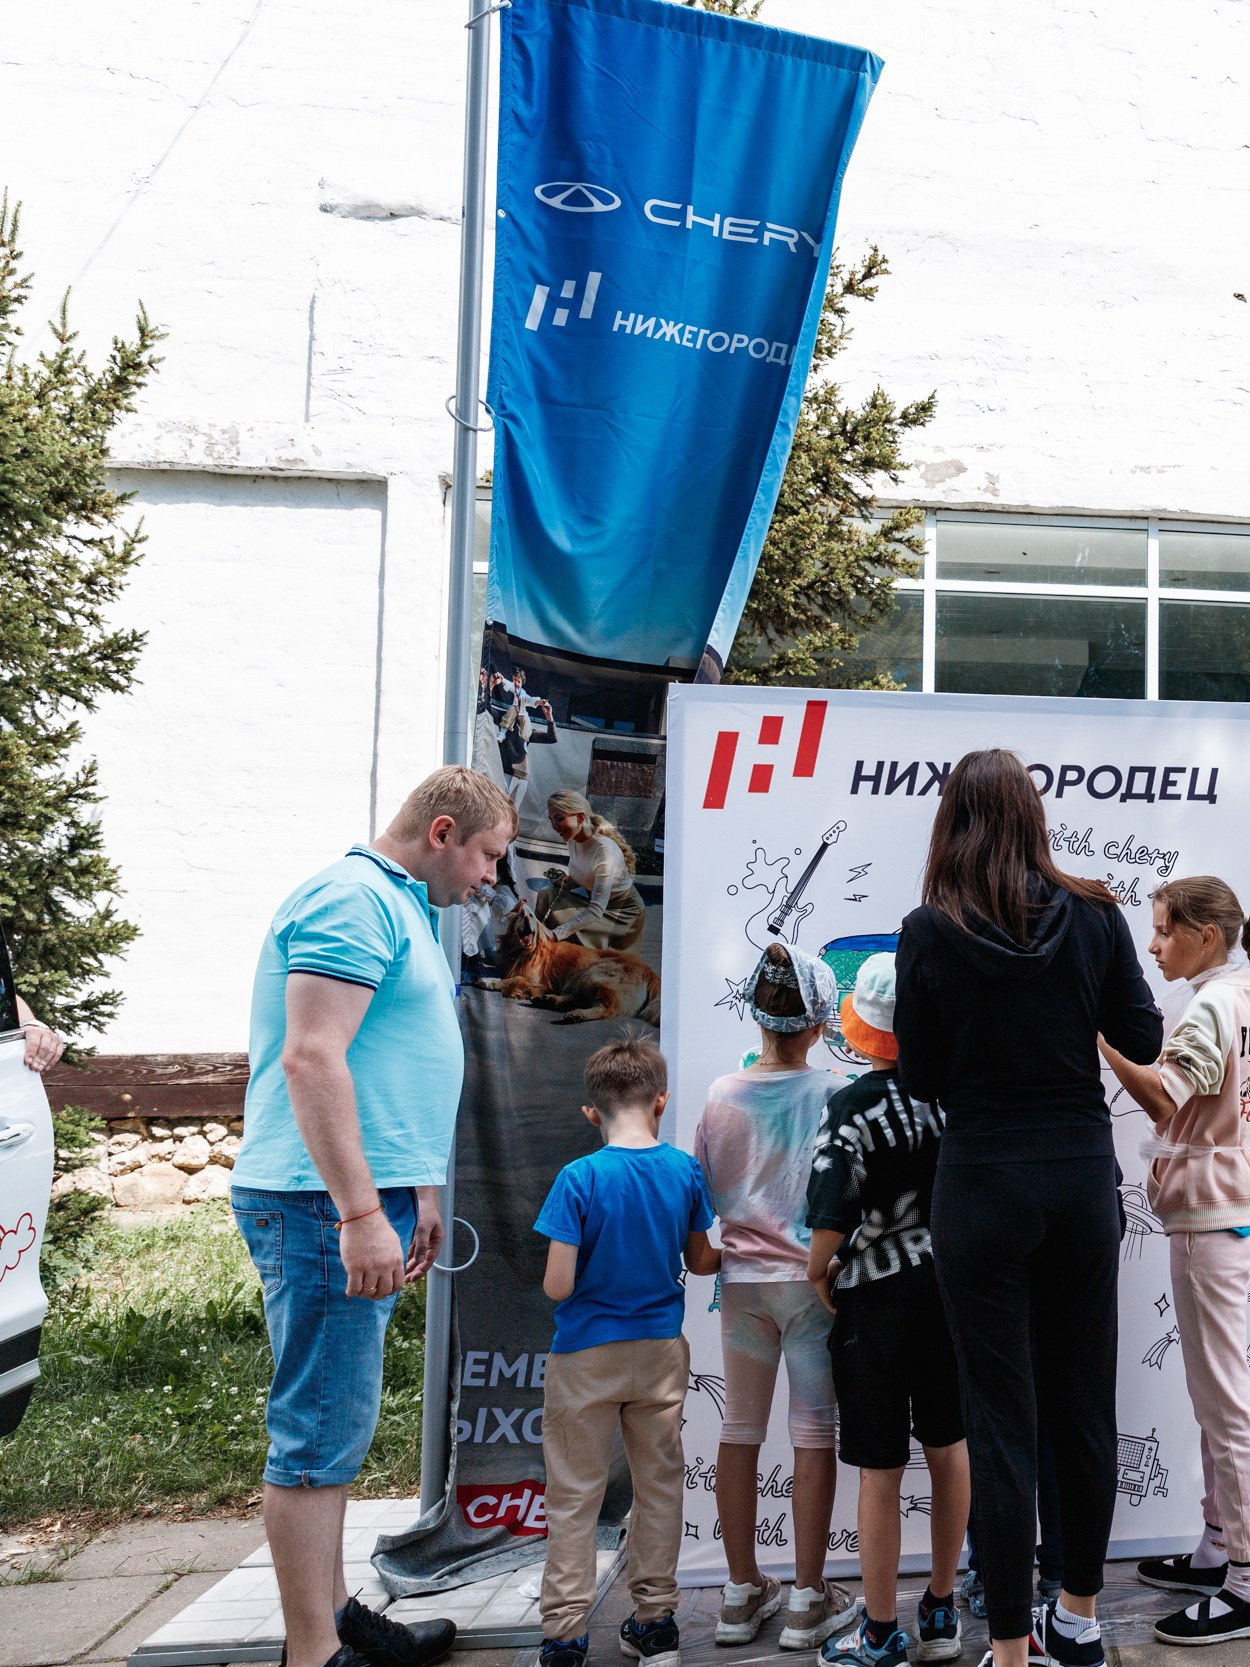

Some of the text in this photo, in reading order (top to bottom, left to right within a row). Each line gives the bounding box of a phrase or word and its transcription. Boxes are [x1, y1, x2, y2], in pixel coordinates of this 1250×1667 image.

[644, 198, 822, 257] CHERY
[850, 760, 1219, 805] НИЖОРОДЕЦ
[1048, 823, 1179, 877] ith chery
[462, 1351, 546, 1388] ЕМЕ
[457, 1407, 544, 1444] ЫХО
[684, 1457, 793, 1498] it che
[466, 1488, 548, 1529] CHE
[713, 1513, 860, 1552] th ve
